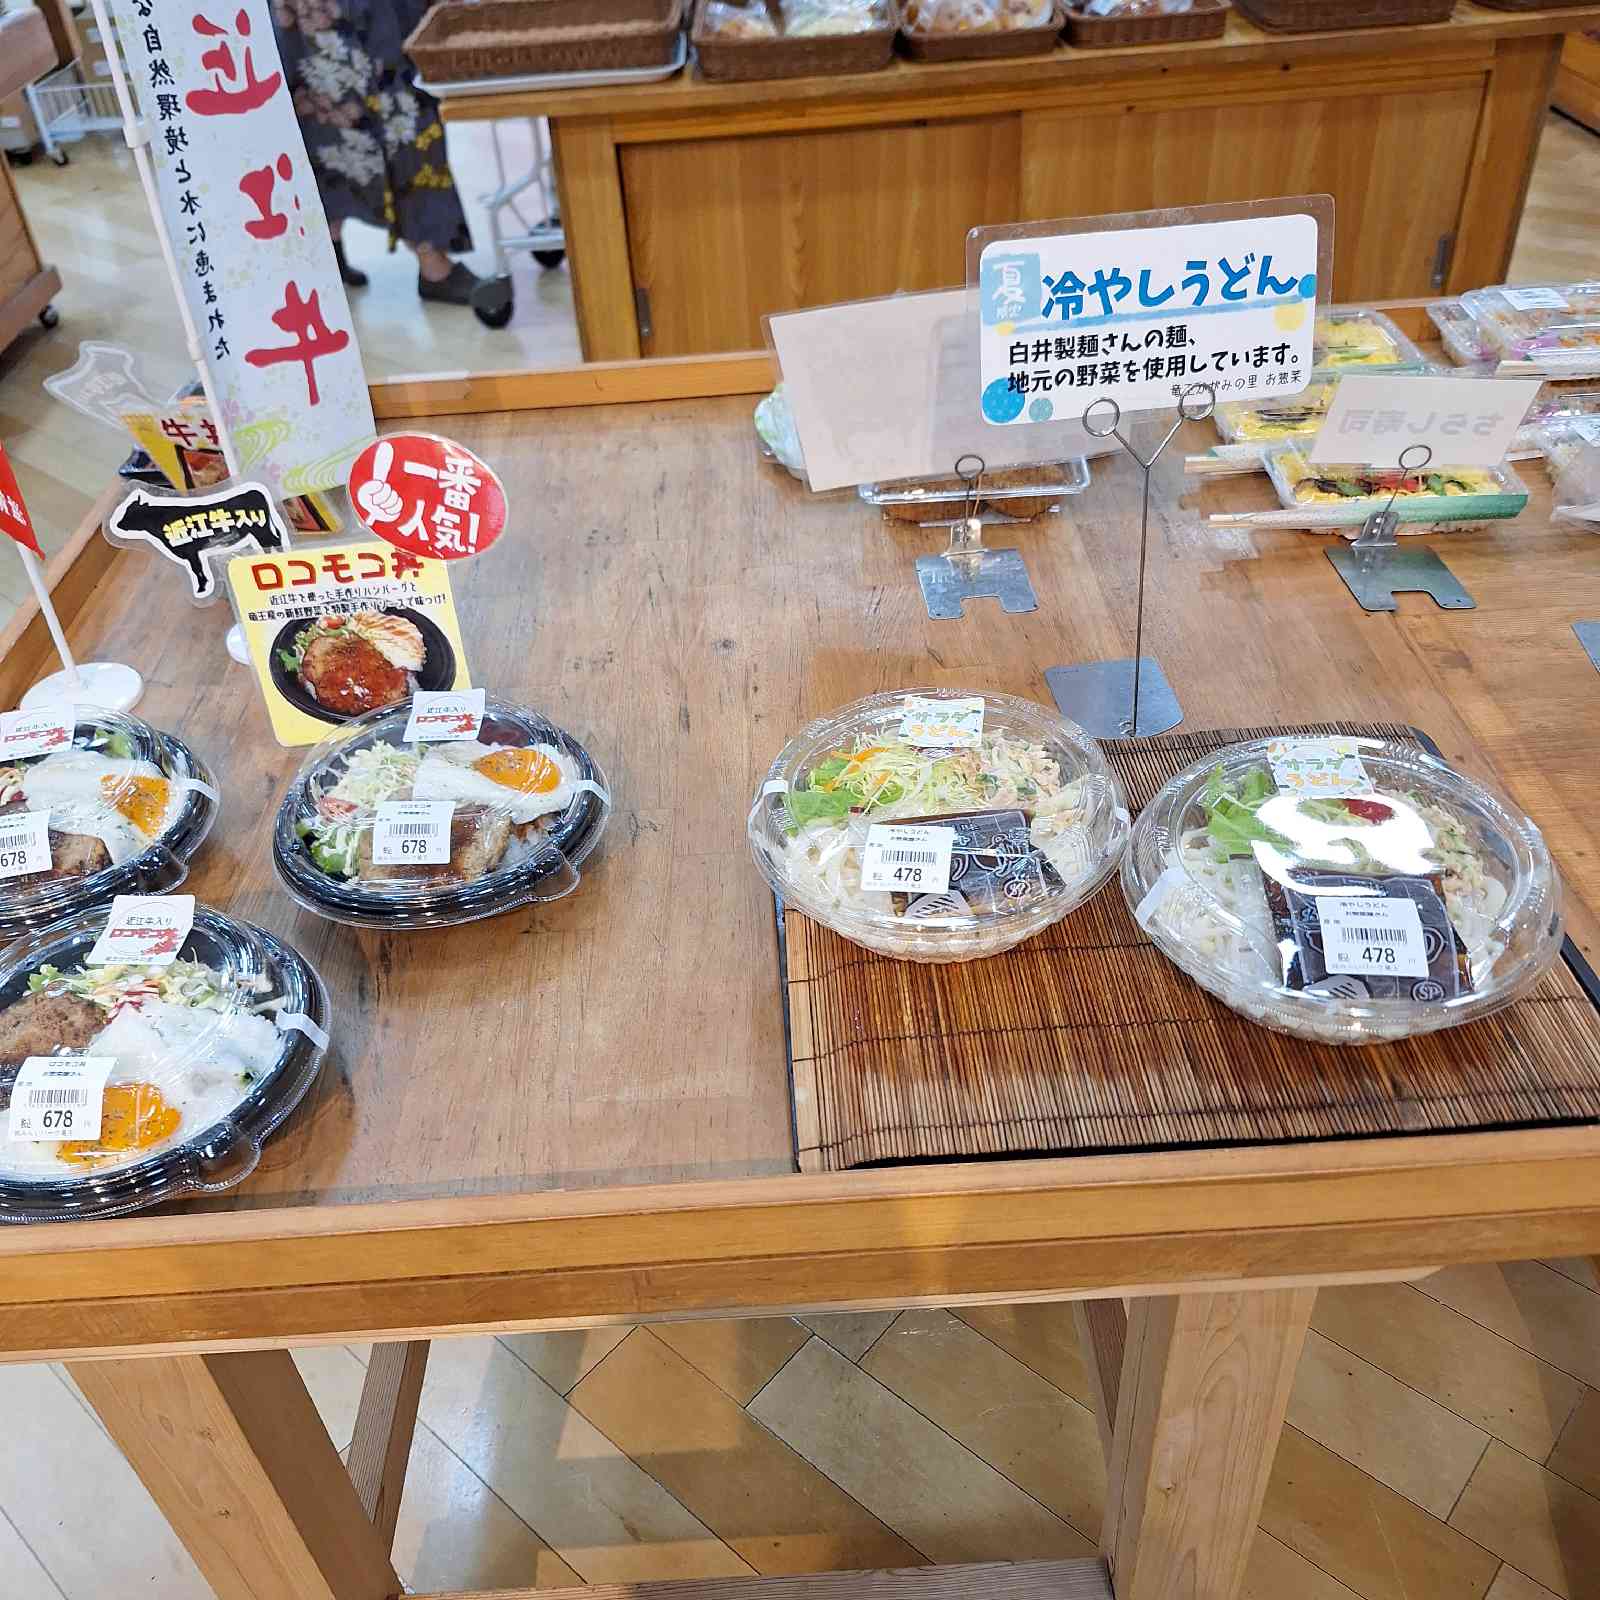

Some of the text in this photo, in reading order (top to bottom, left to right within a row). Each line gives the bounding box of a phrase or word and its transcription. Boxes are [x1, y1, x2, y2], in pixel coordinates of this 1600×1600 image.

[1041, 252, 1299, 320] 冷やしうどん
[1007, 343, 1300, 394] 地元の野菜を使用しています。
[403, 456, 481, 511] 一番
[163, 508, 267, 547] 近江牛入り
[251, 550, 424, 590] ロコモコ丼
[1, 851, 27, 867] 678
[402, 840, 427, 854] 678
[894, 867, 922, 882] 478
[1363, 947, 1396, 964] 478
[43, 1109, 73, 1128] 678
